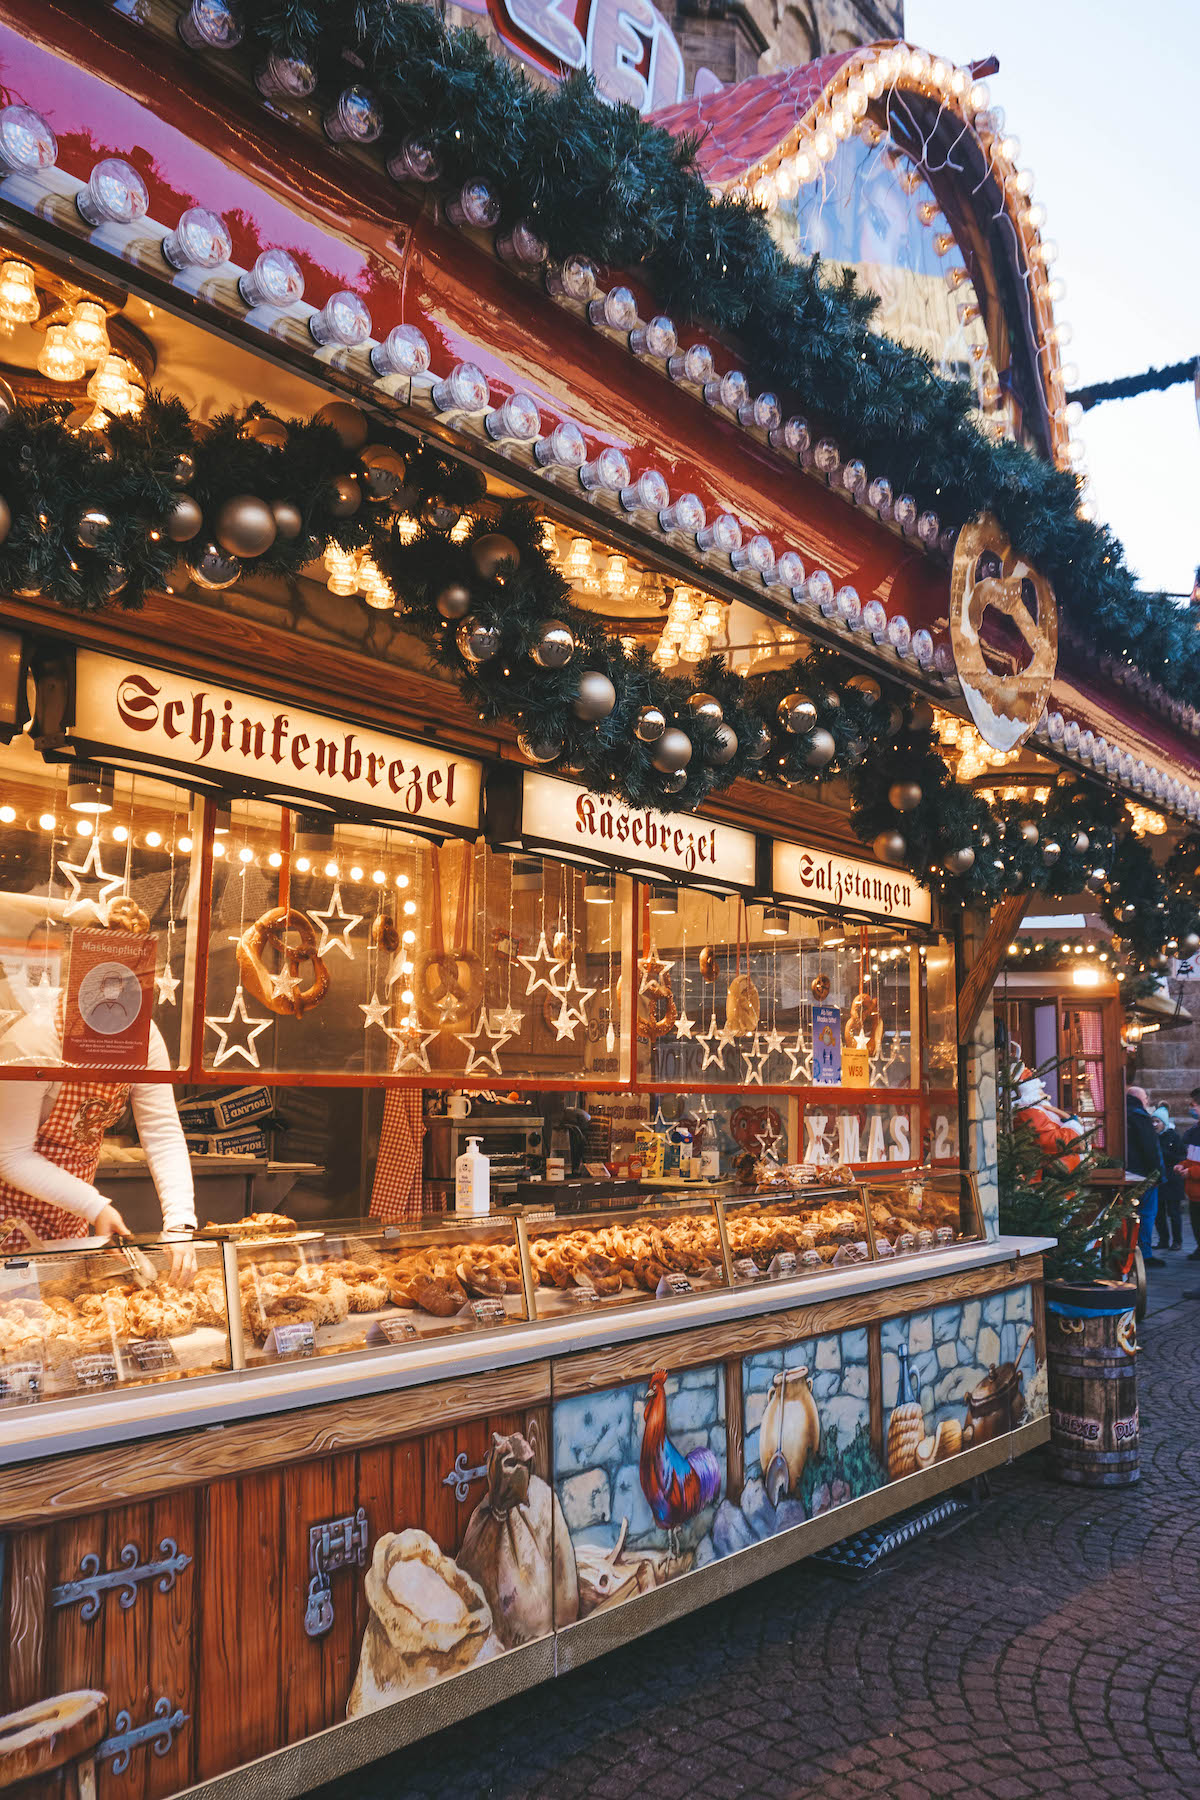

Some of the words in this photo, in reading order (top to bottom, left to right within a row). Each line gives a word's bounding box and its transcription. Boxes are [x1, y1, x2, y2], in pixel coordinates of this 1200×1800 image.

[116, 674, 457, 814] Schinkenbrezel
[575, 792, 718, 871] Käsebrezel
[798, 854, 912, 914] Salzstangen
[81, 941, 148, 957] Maskenpflicht
[848, 1065, 863, 1077] W58
[230, 1098, 266, 1118] ROLAND
[803, 1115, 910, 1164] XMAS
